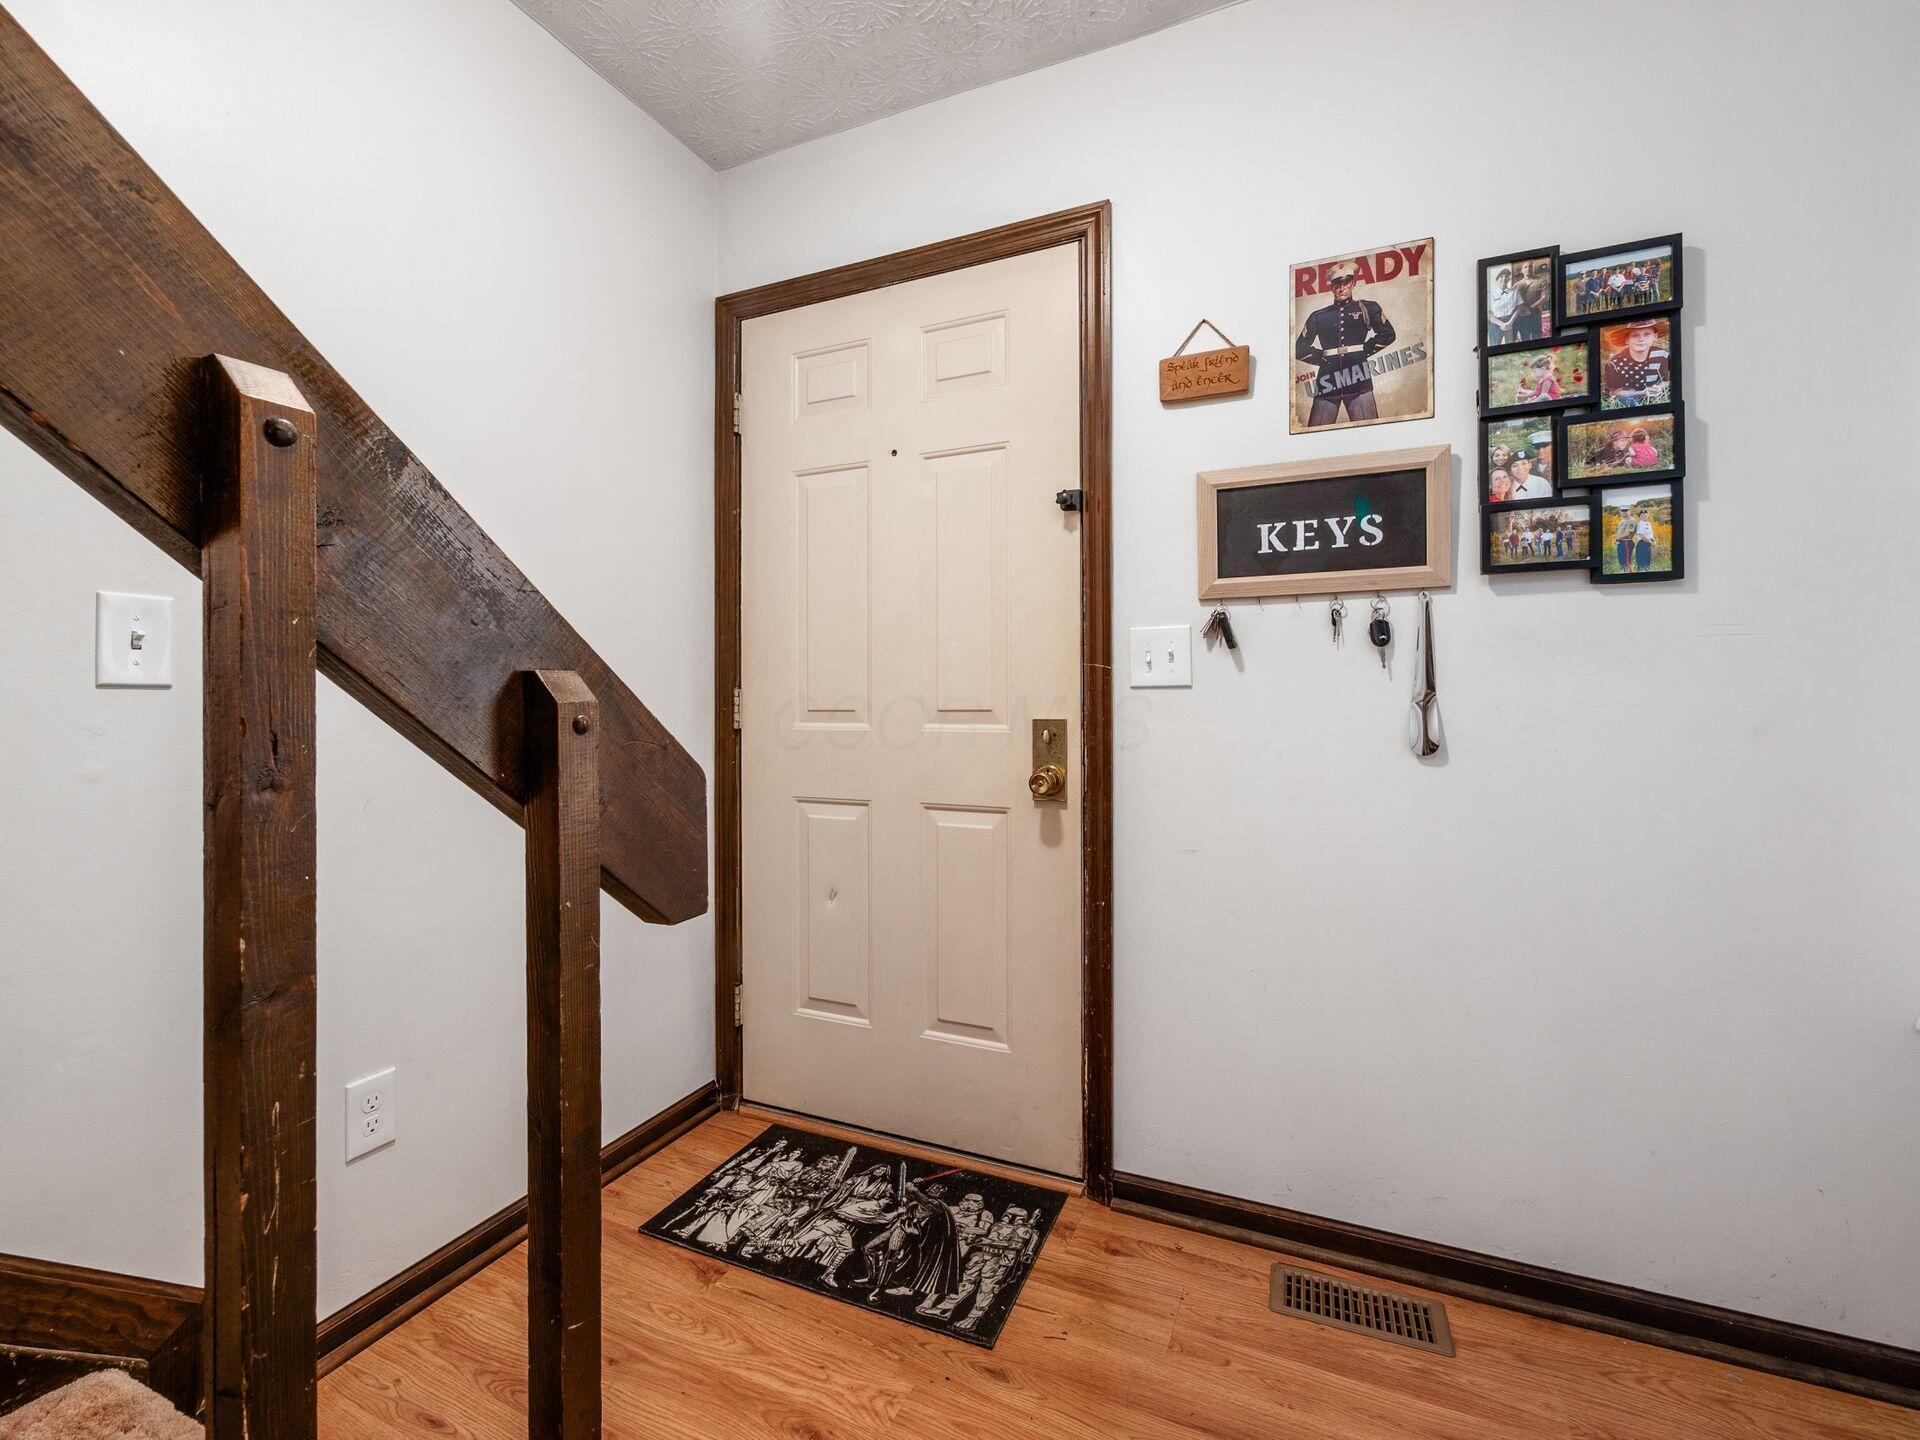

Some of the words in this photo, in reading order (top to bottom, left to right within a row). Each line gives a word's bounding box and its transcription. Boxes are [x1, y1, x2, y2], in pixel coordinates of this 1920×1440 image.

[1295, 244, 1427, 298] READY
[1295, 370, 1316, 384] JOIN
[1256, 513, 1384, 555] KEYS
